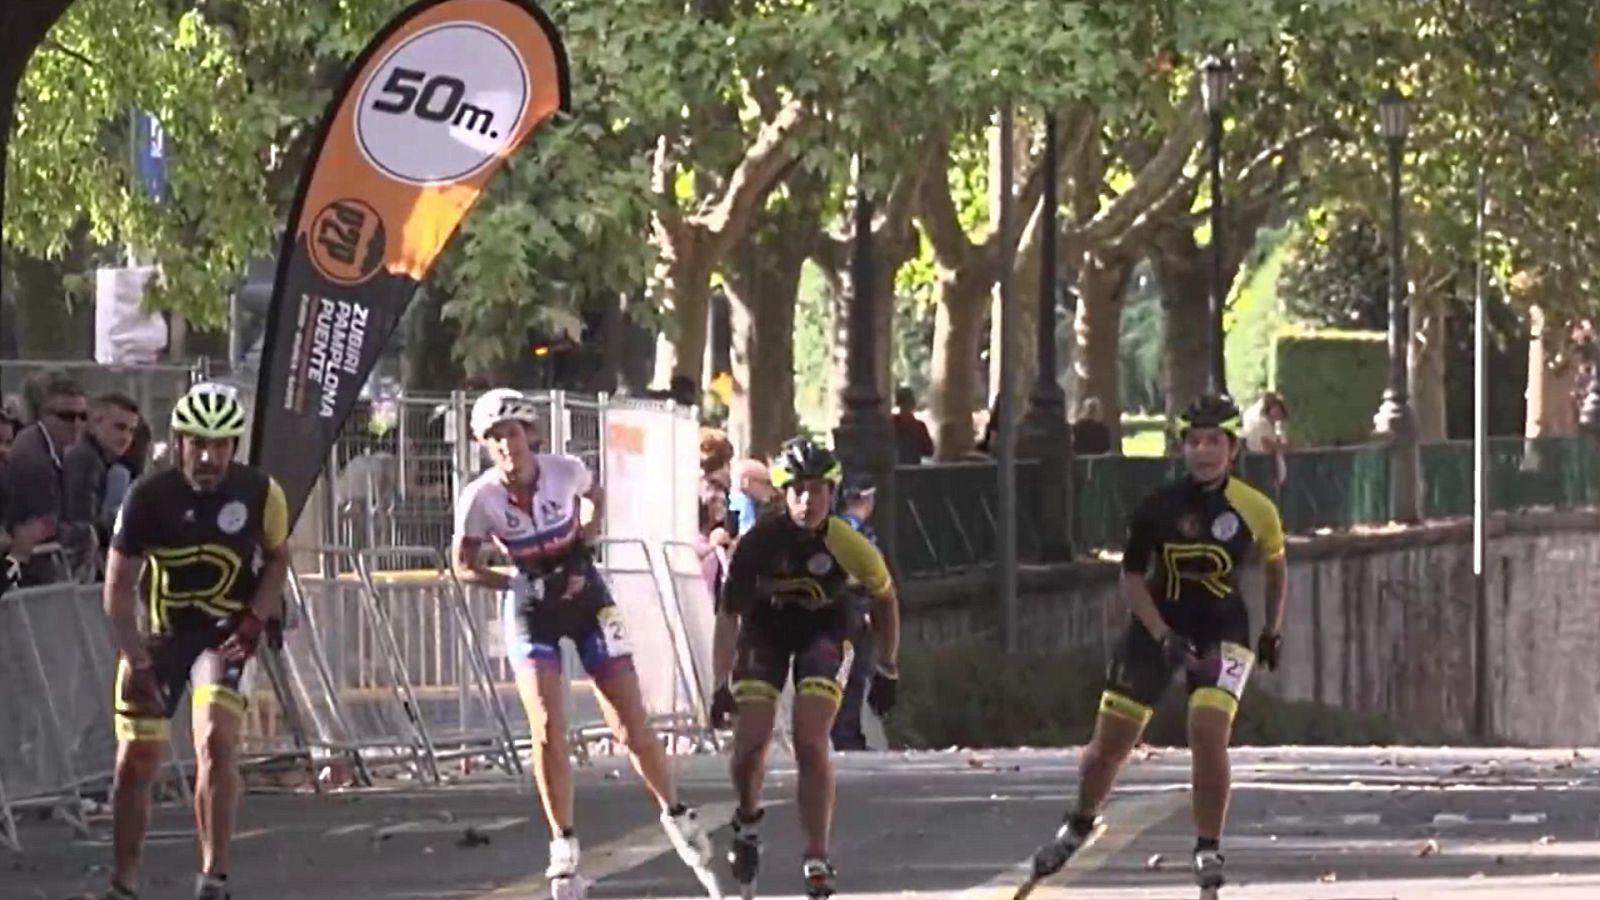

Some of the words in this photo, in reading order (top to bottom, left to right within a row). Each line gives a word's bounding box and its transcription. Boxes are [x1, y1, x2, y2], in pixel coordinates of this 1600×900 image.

[308, 299, 335, 383] PUENTE
[319, 300, 351, 418] PAMPLONA
[343, 302, 369, 374] ZUBIRI
[148, 544, 243, 635] R
[1164, 543, 1231, 600] R
